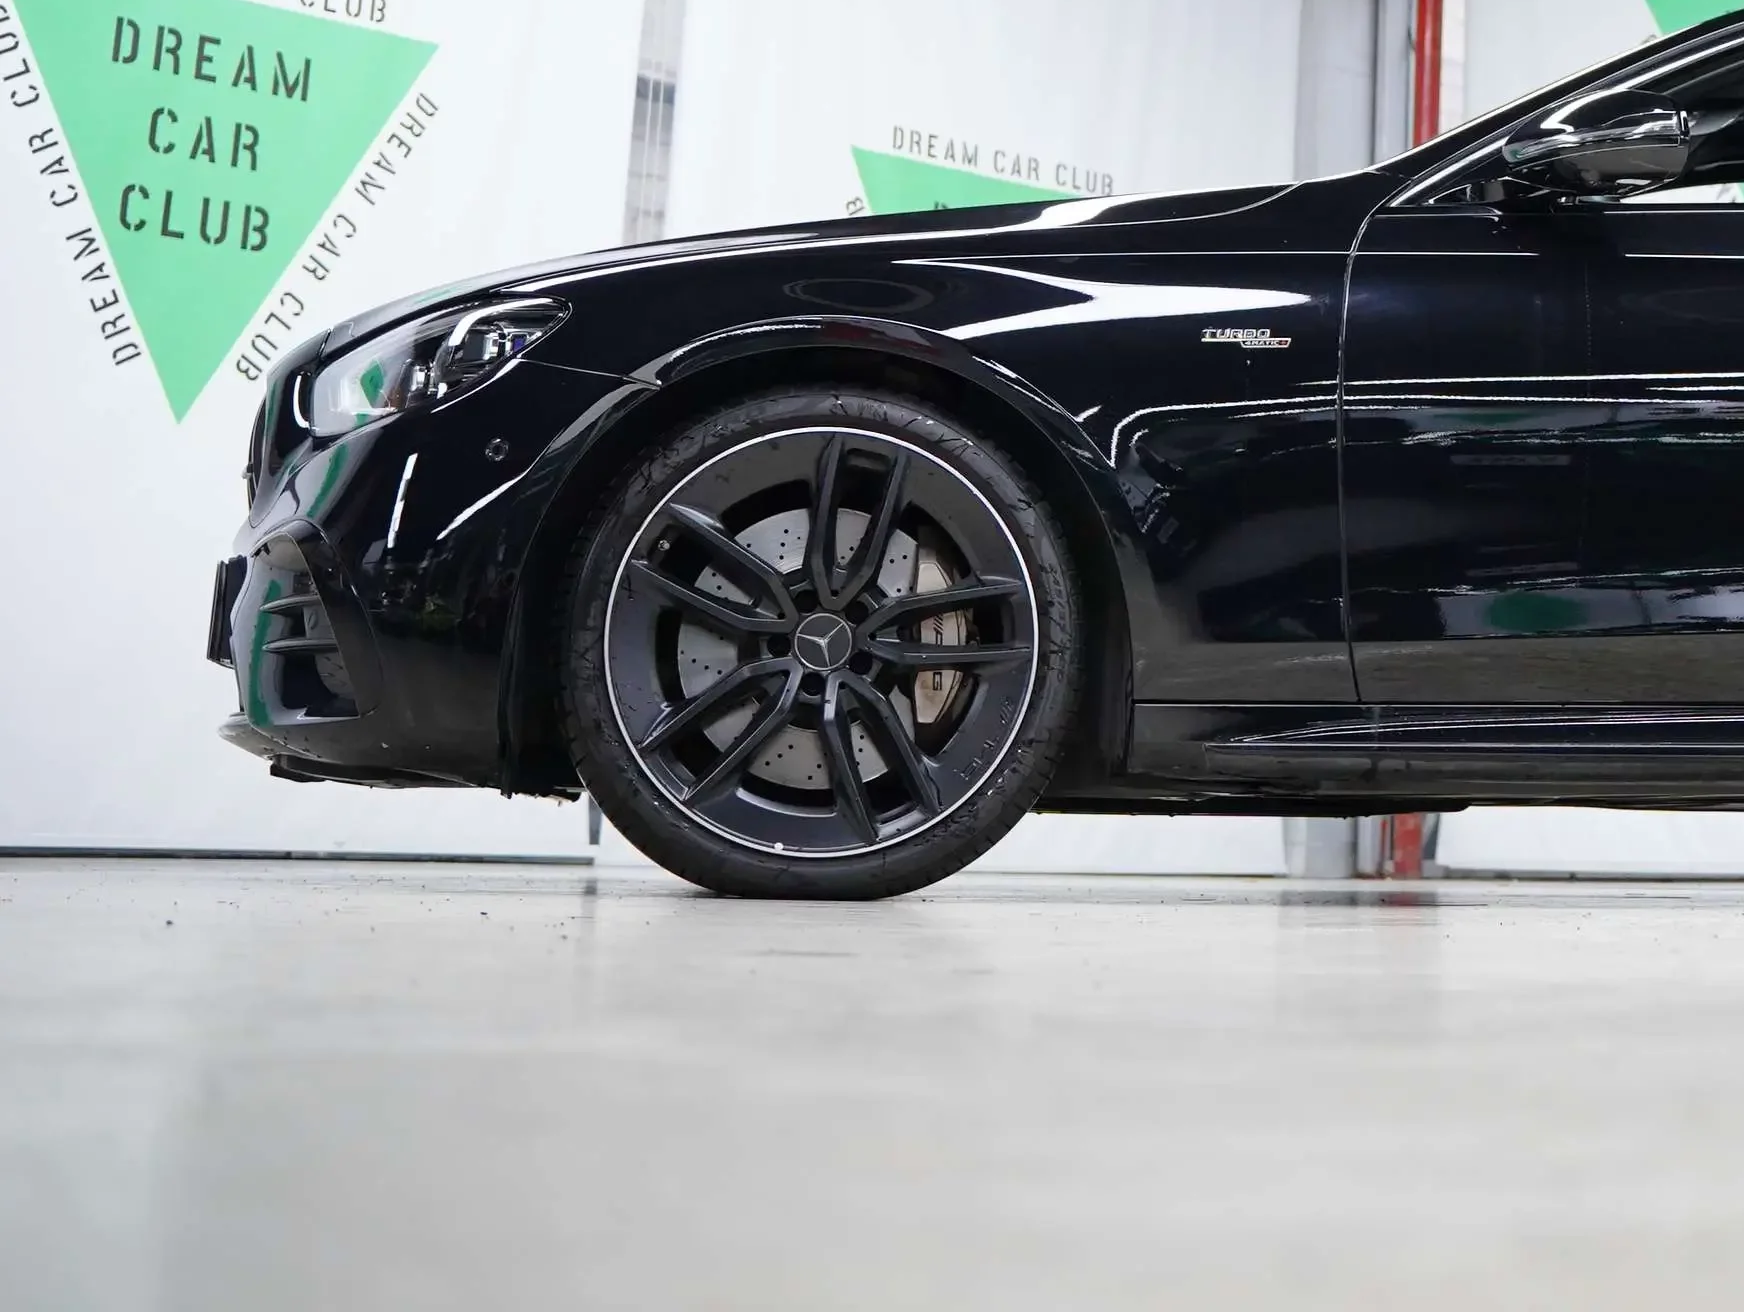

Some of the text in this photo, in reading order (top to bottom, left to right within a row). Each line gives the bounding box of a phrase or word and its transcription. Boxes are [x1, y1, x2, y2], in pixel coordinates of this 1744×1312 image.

[111, 16, 313, 102] DREAM
[28, 127, 79, 208] CAR
[148, 107, 261, 171] CAR
[892, 125, 1114, 196] DREAM CAR CLUB
[119, 183, 271, 251] CLUB
[235, 92, 439, 381] DREAM CAR CLUB
[65, 227, 142, 367] DREAM
[1202, 327, 1270, 338] TURBO
